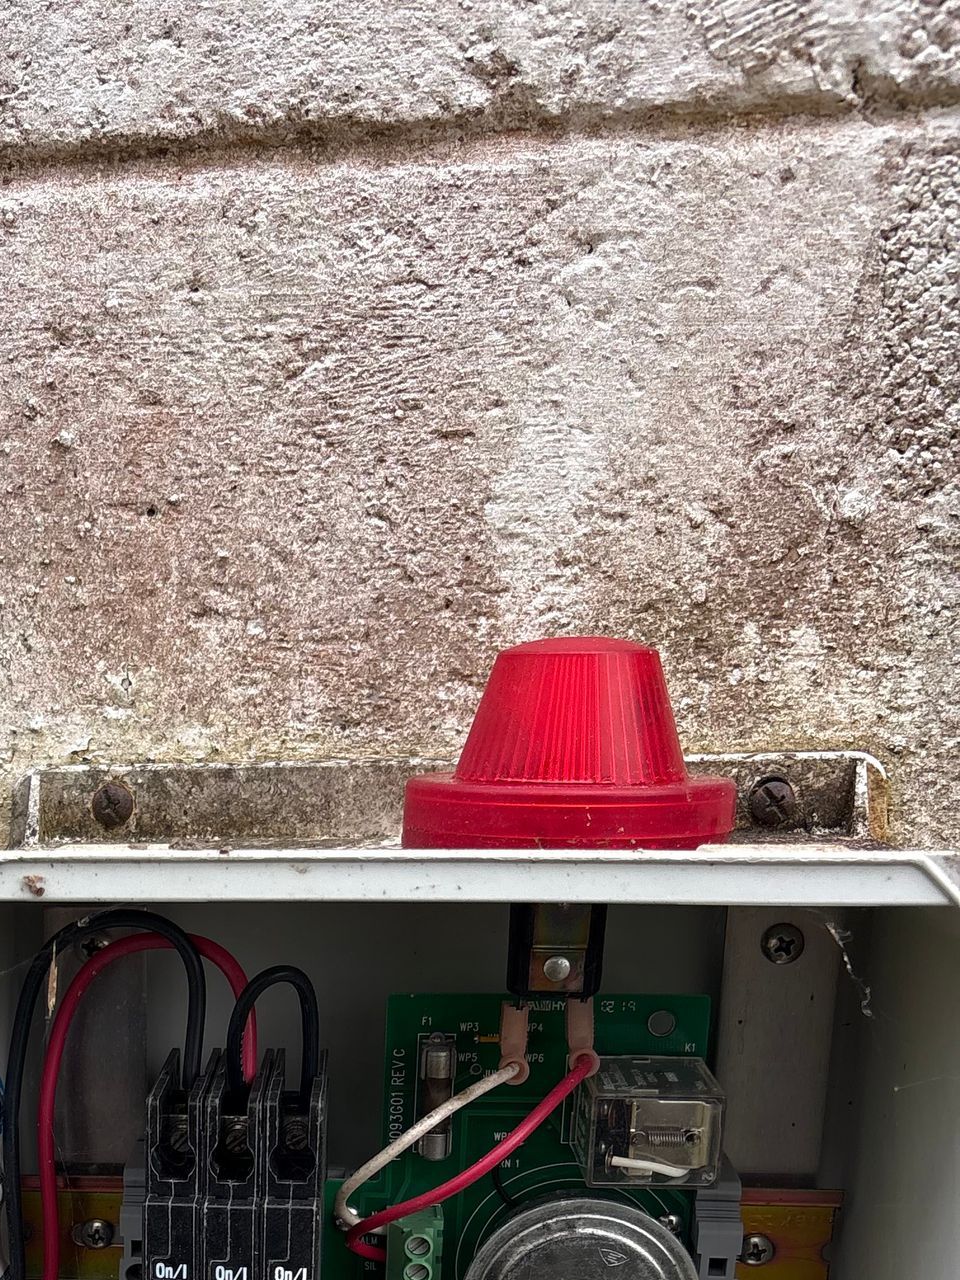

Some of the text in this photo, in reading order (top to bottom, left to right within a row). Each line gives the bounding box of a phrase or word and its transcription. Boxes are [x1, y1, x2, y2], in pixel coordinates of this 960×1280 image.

[422, 1016, 432, 1026] F1
[460, 1022, 479, 1032] WP3
[393, 1048, 405, 1057] C
[684, 1043, 696, 1053] K1
[458, 1052, 478, 1062] WP5
[391, 1060, 405, 1086] REV
[364, 1261, 377, 1271] SIL
